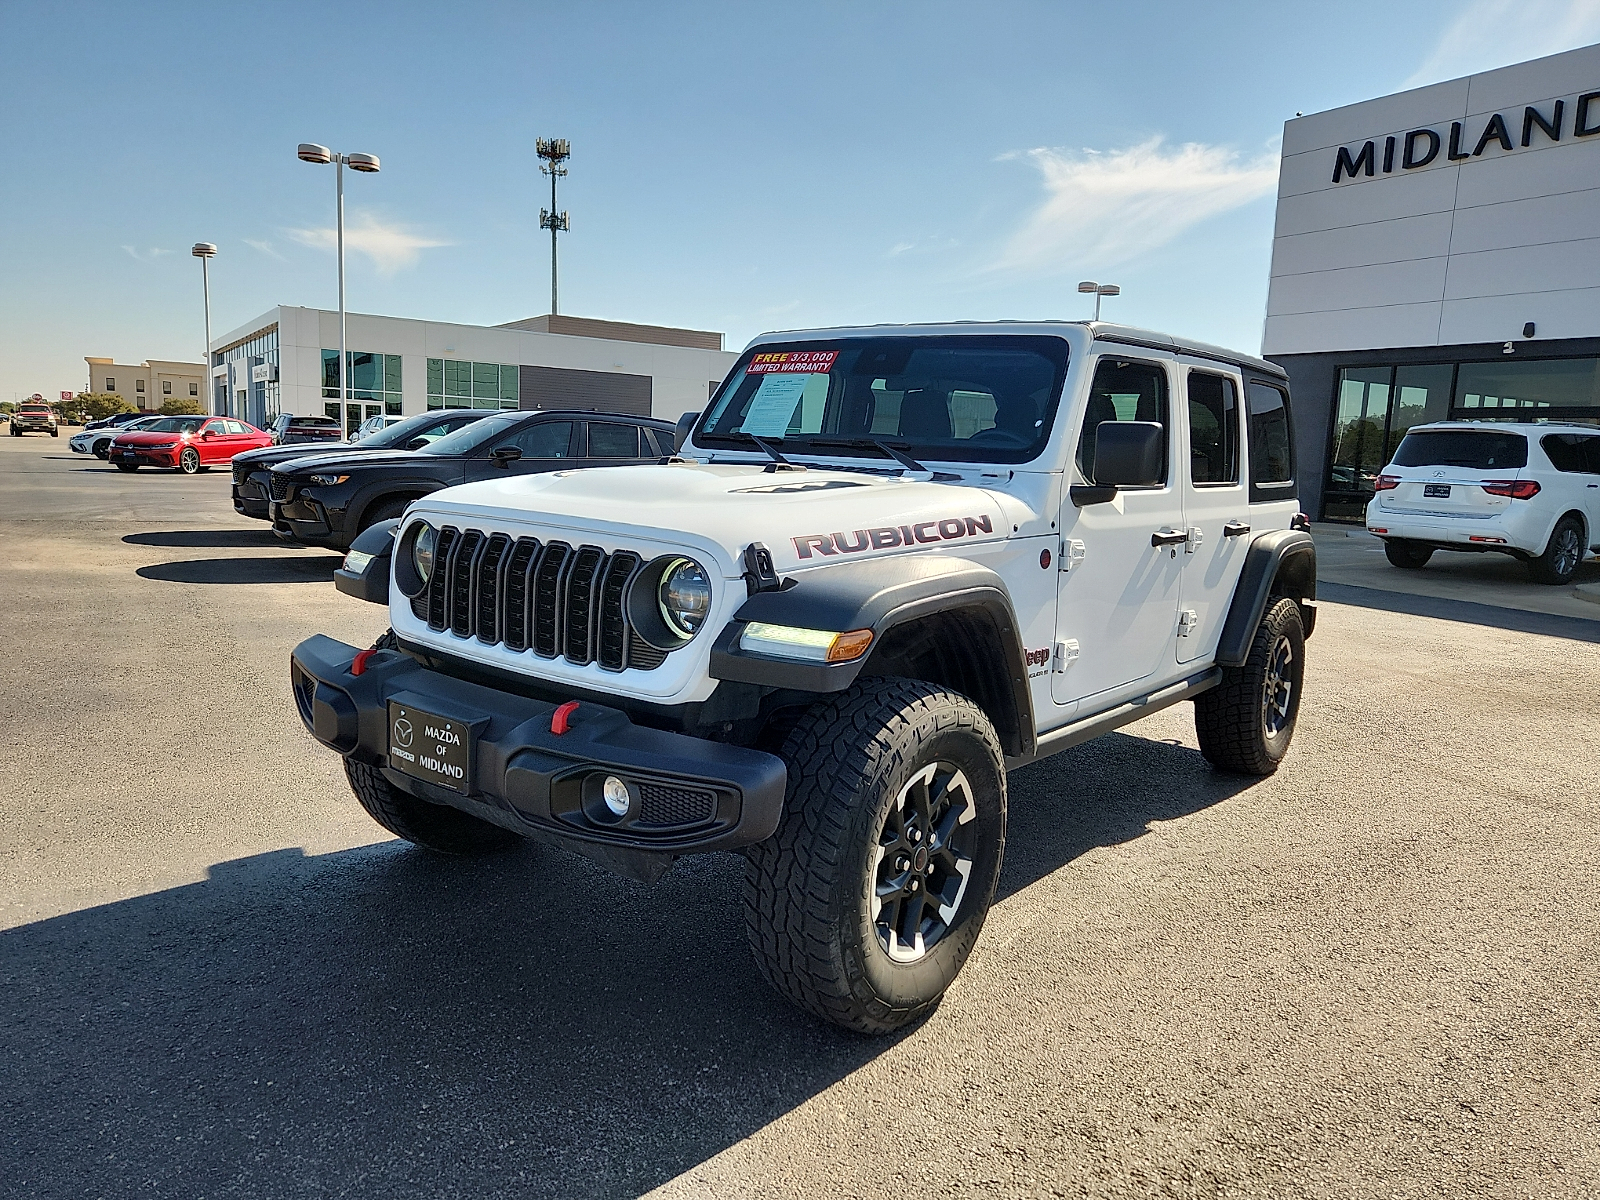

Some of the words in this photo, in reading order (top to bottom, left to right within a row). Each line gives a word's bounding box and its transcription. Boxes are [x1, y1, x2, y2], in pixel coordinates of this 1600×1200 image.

[755, 354, 788, 363] FREE
[790, 352, 834, 362] 3/3,000
[748, 363, 779, 372] LIMITED
[781, 362, 830, 372] WARRANTY
[791, 515, 993, 559] RUBICON
[424, 725, 460, 746] MAZDA
[391, 746, 415, 762] mazda
[436, 745, 447, 757] OF
[420, 755, 464, 779] MIDLAND
